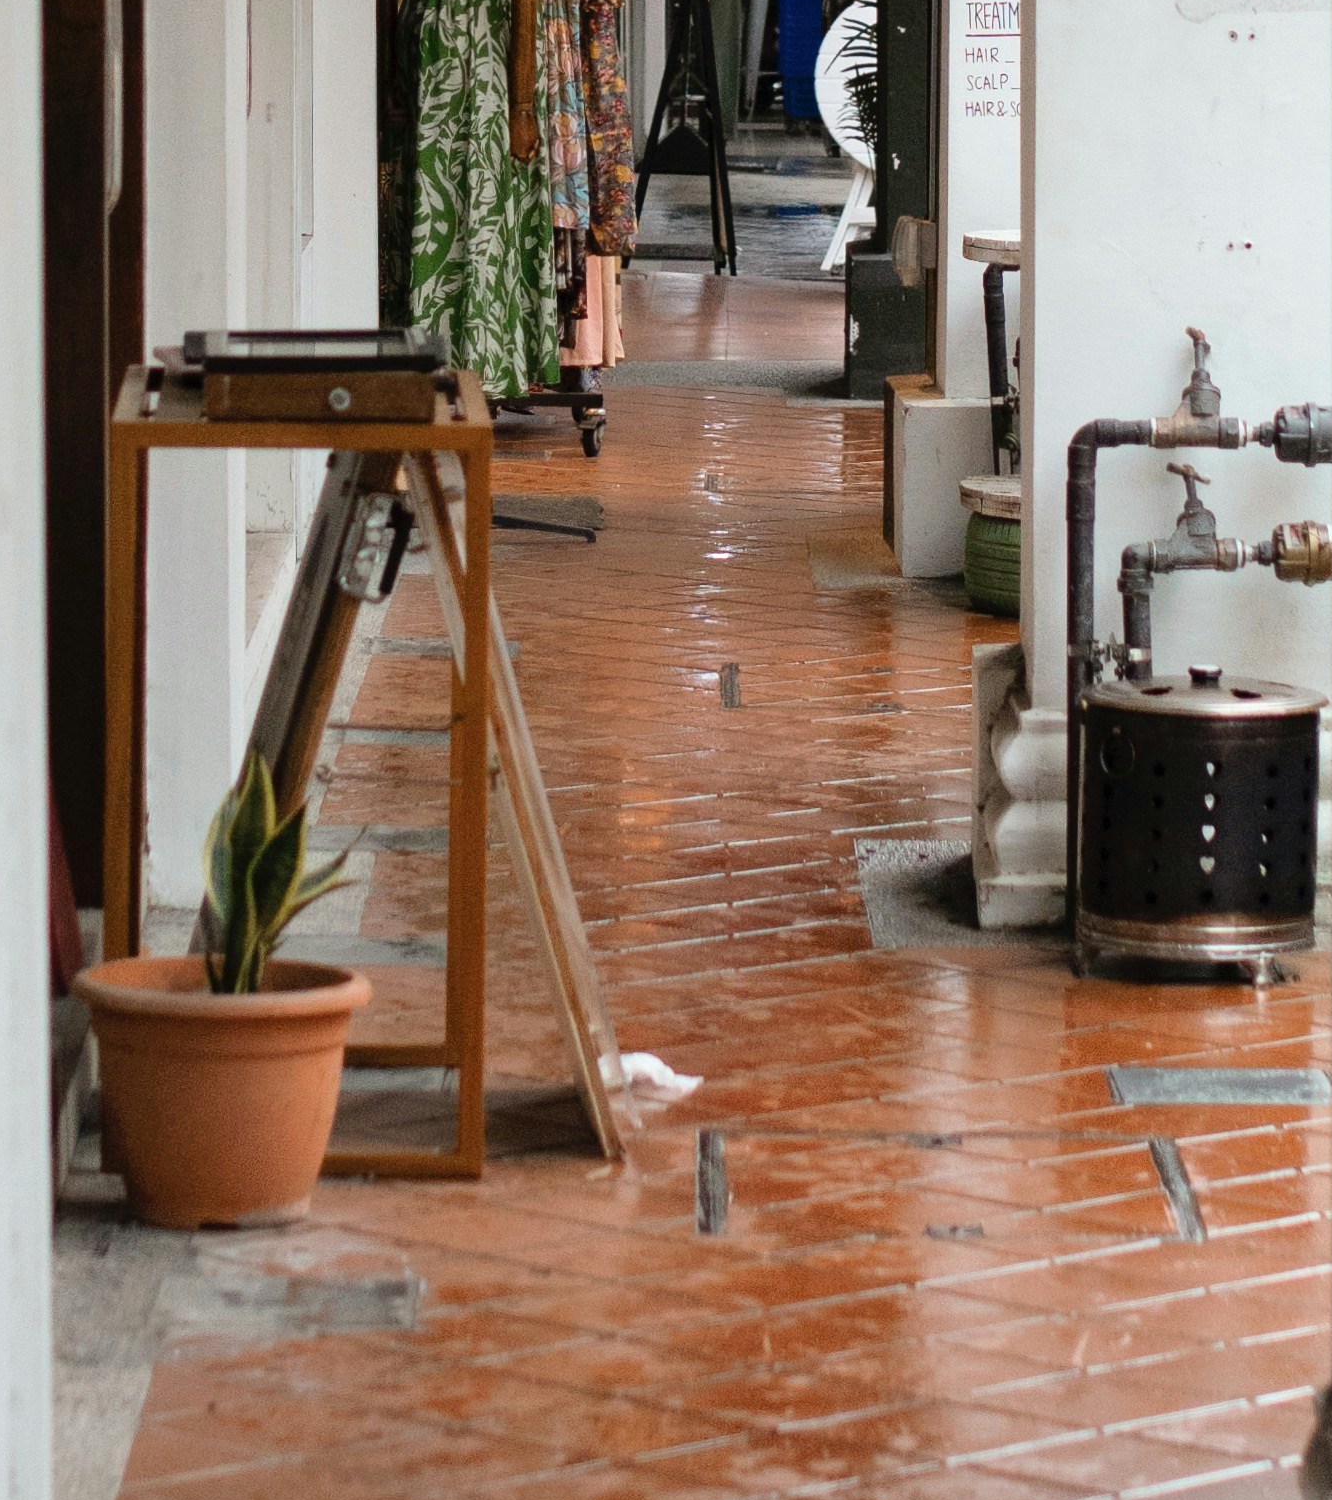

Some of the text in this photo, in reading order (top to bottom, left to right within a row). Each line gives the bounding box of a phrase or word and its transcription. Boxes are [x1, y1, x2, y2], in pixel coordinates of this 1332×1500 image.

[965, 1, 1020, 29] TREATM
[965, 47, 999, 63] HAIR
[967, 73, 1009, 91] SCALP
